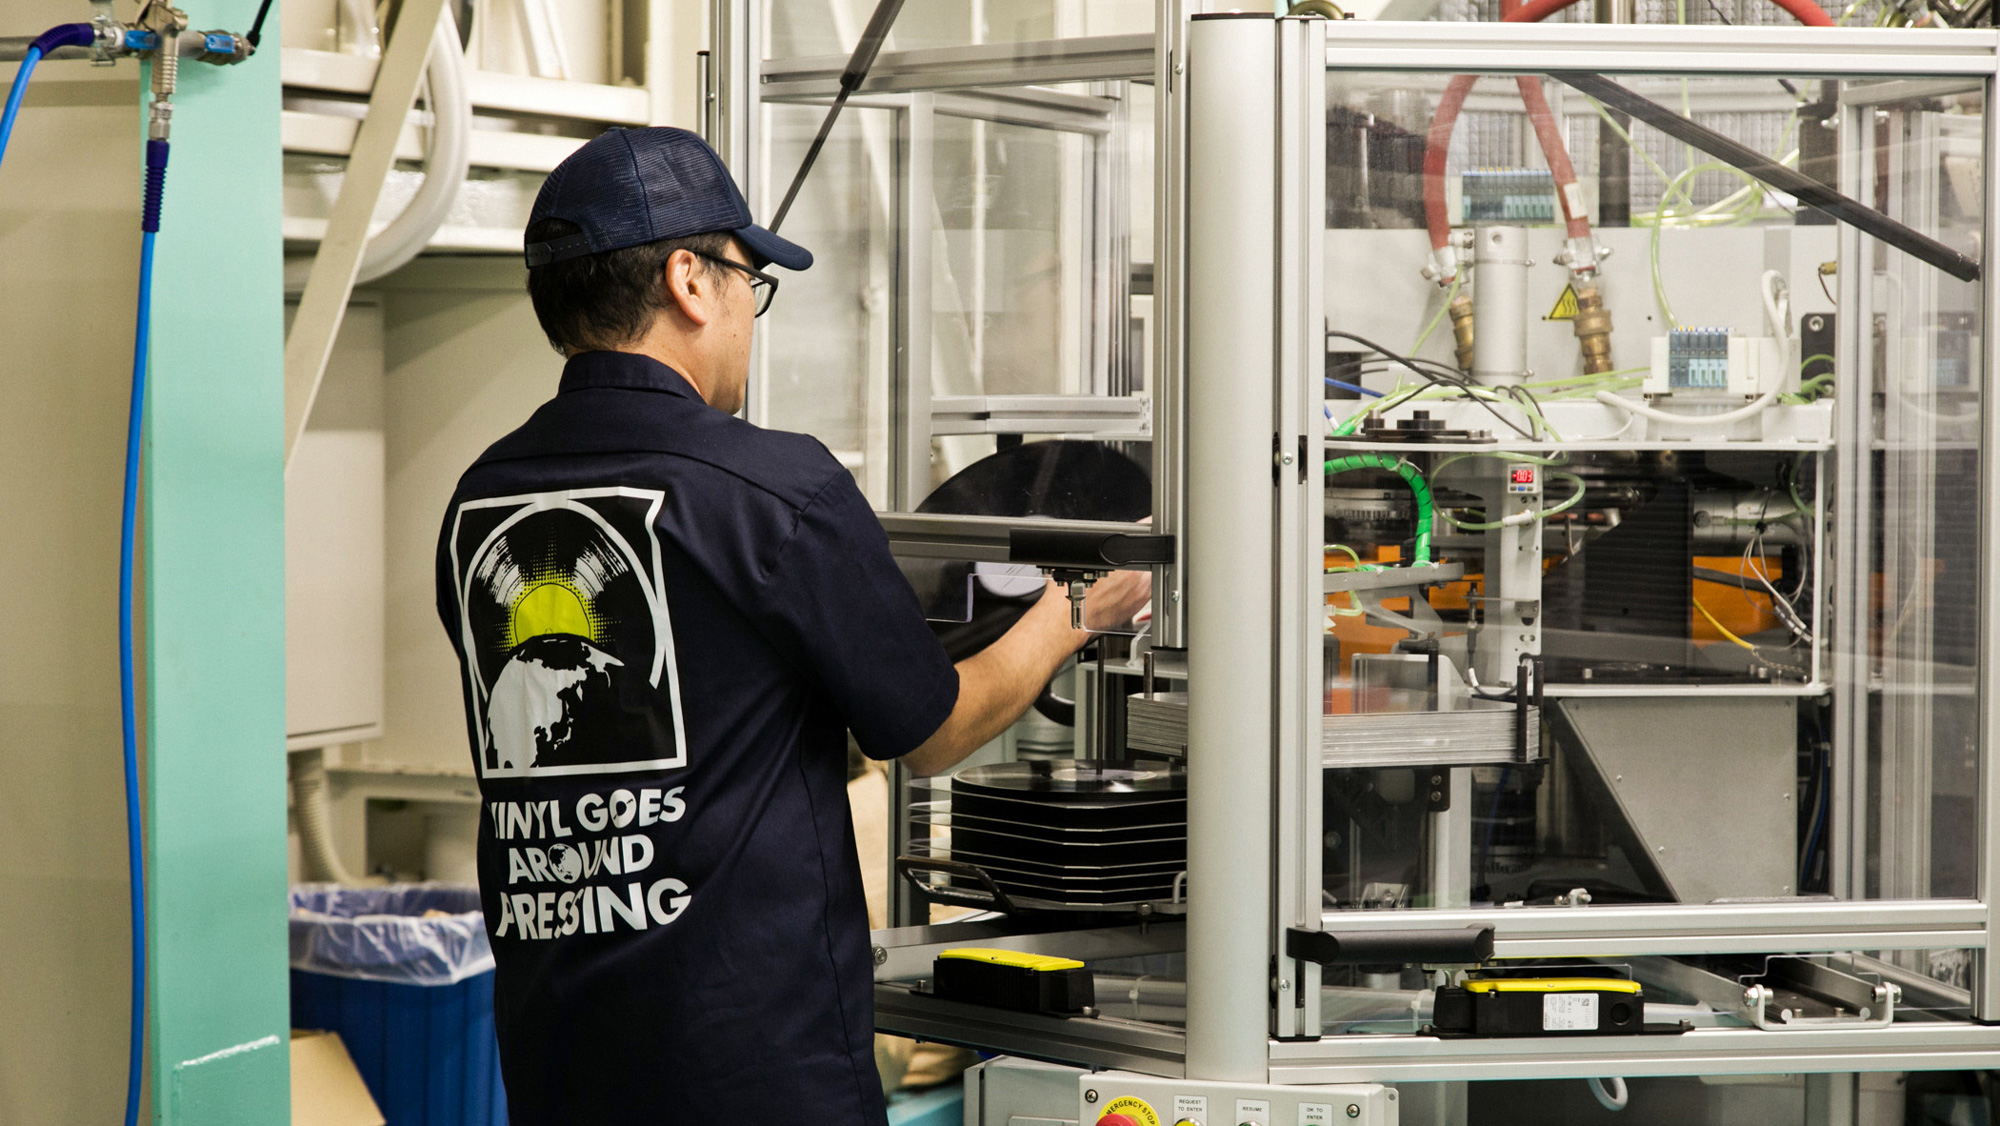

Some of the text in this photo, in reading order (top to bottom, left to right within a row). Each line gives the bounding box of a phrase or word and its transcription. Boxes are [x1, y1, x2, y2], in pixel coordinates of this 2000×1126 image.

[576, 786, 687, 832] GOES
[508, 833, 655, 885] AROUND
[1106, 1099, 1156, 1125] MERGENCY STOP
